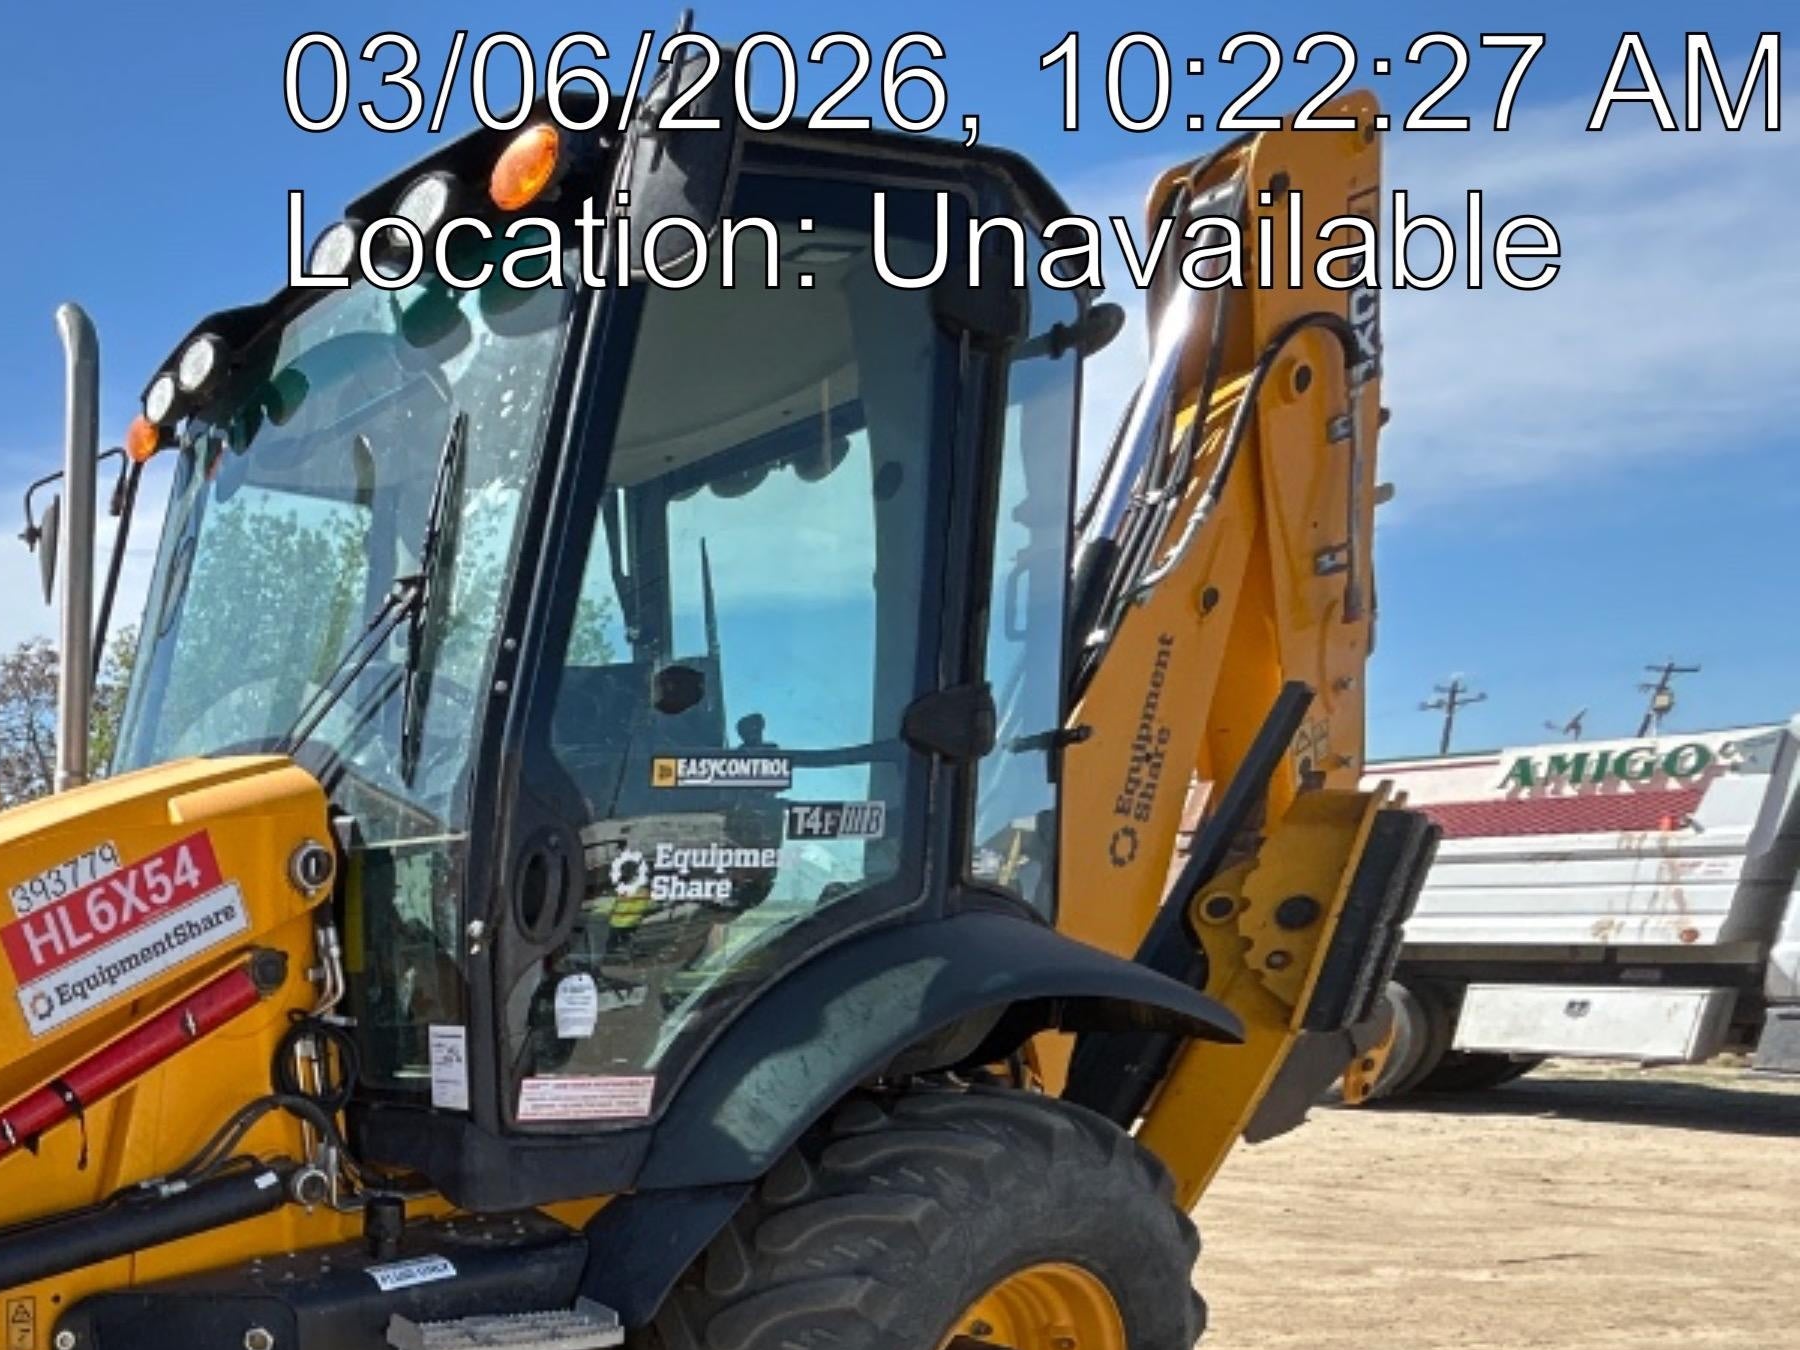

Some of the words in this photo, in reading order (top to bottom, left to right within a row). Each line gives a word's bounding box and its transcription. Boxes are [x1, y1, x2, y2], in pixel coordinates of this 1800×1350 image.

[677, 757, 790, 779] EASYCONTROL
[1114, 632, 1175, 817] Equipment
[1134, 726, 1171, 823] Share
[11, 841, 120, 914] 393779
[21, 845, 200, 967] HL6X54
[651, 874, 733, 900] Share
[54, 903, 237, 1008] EquipmentShare
